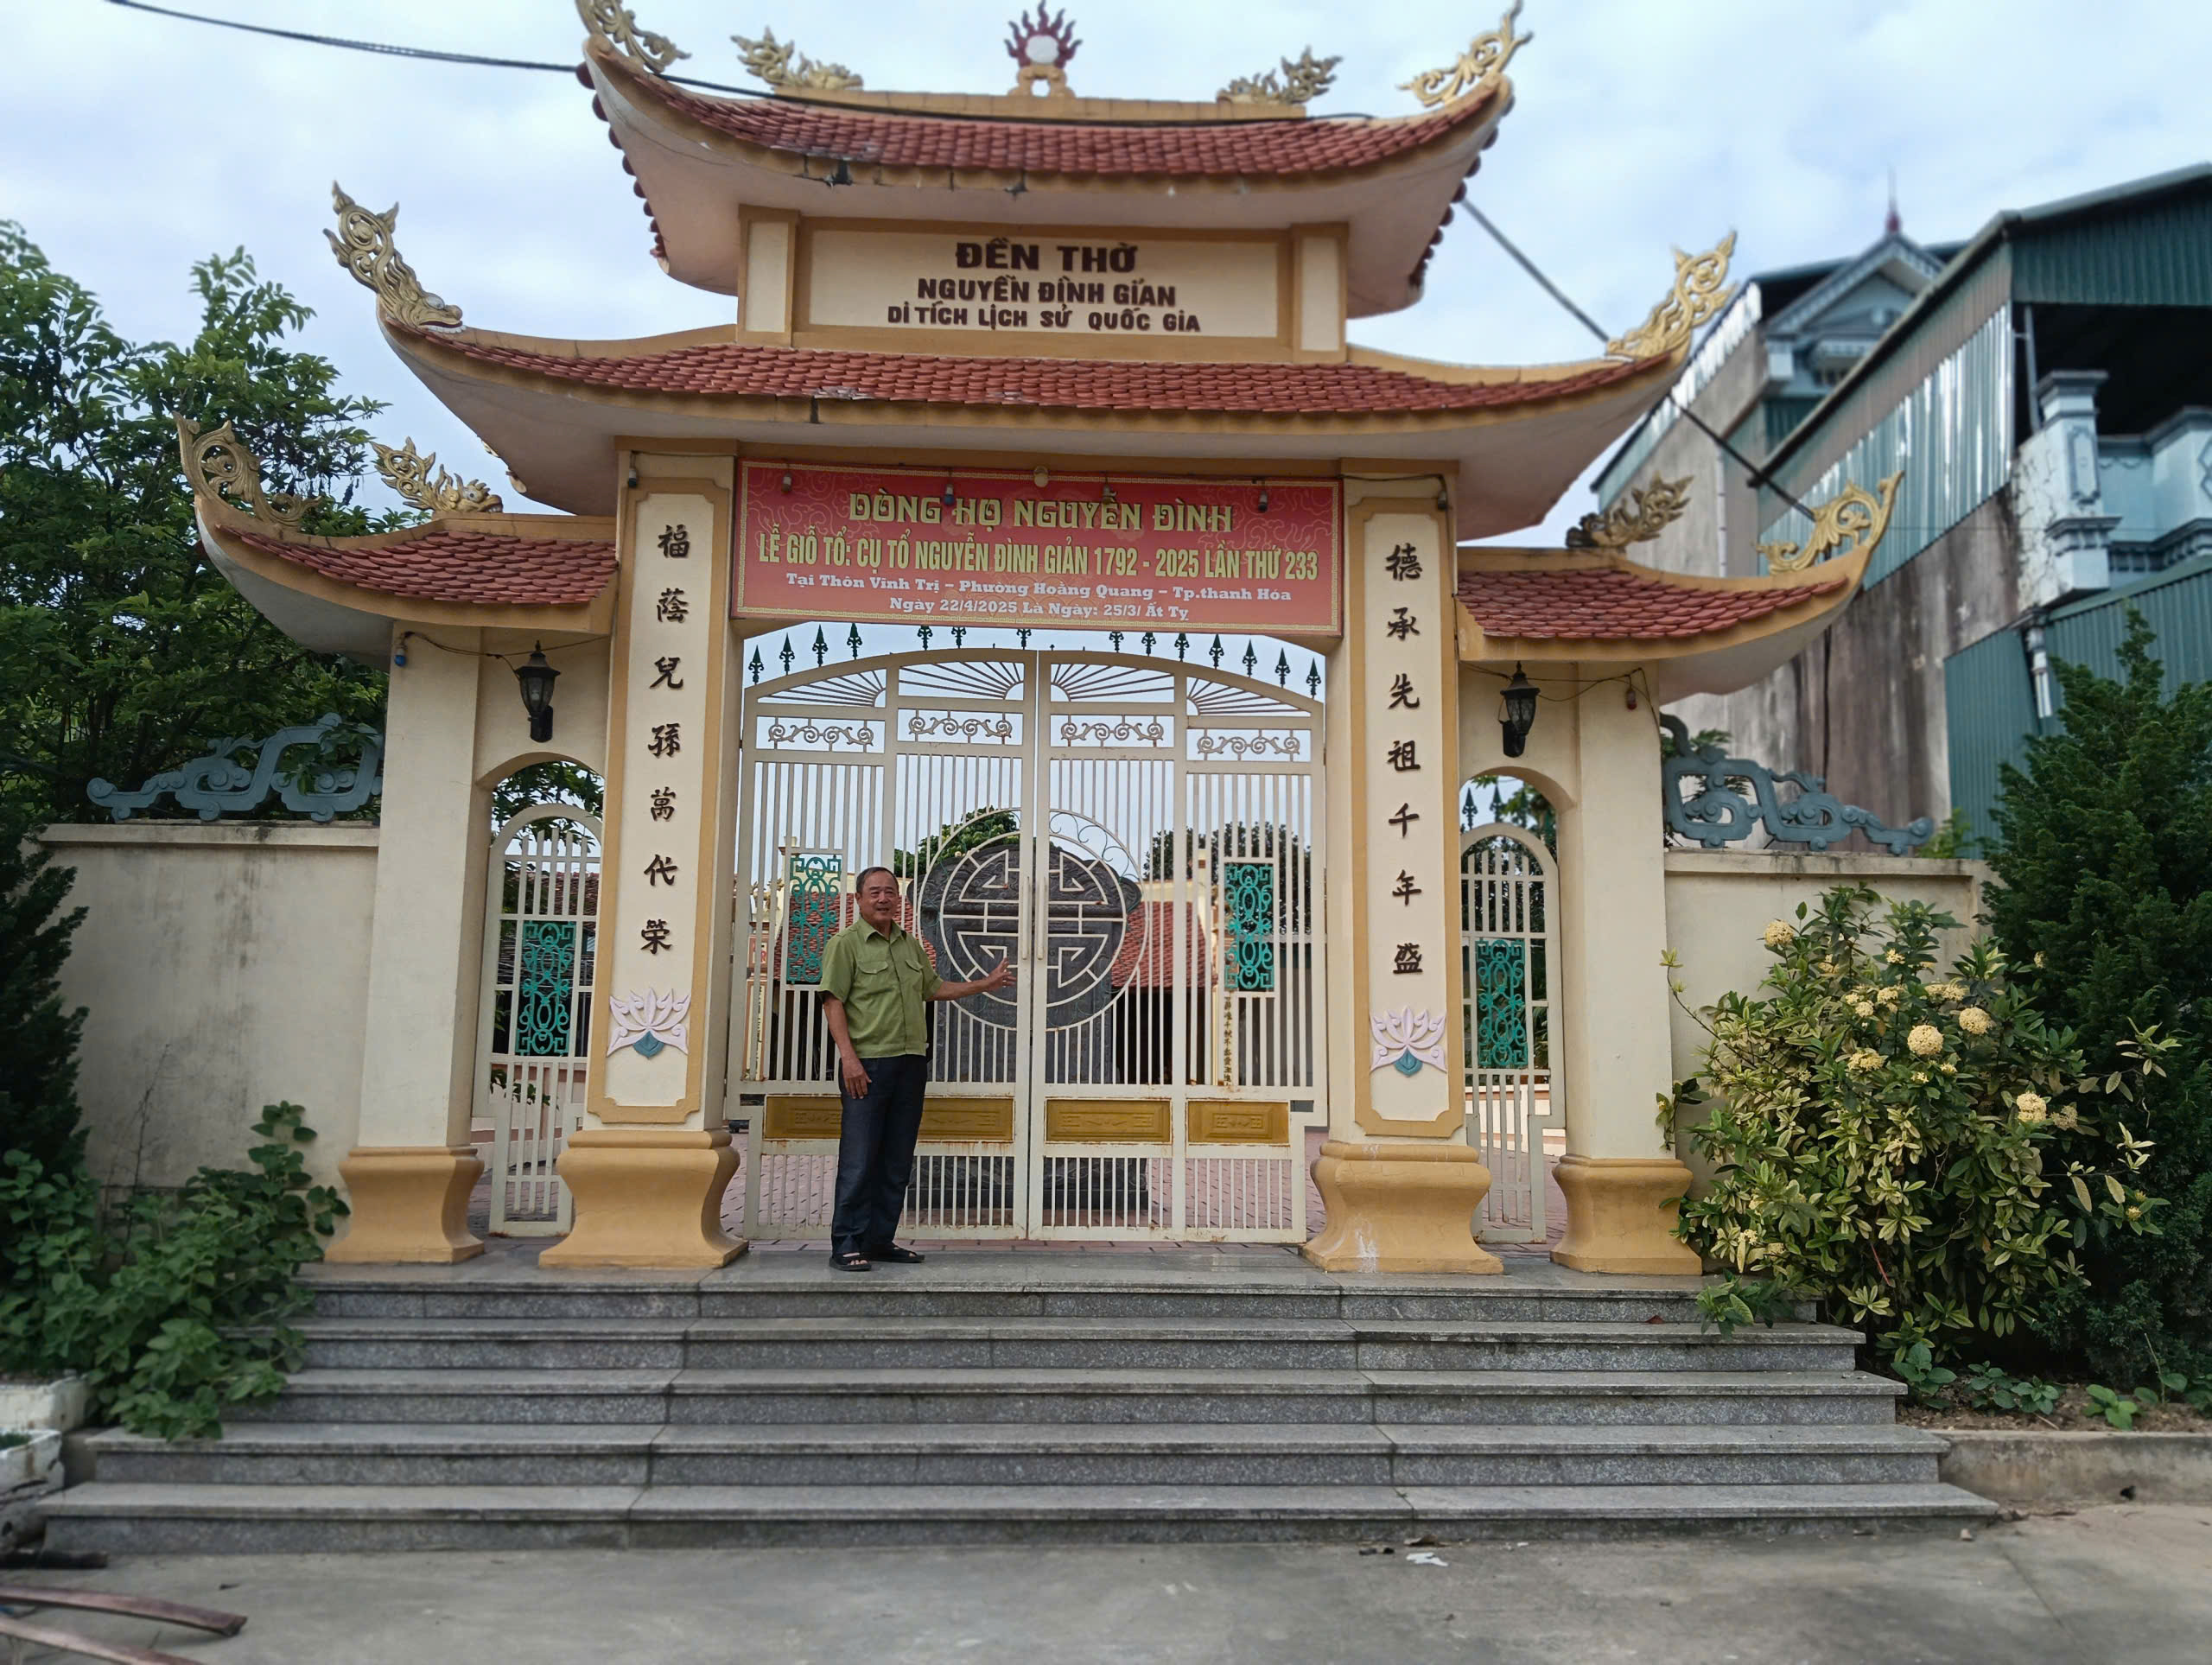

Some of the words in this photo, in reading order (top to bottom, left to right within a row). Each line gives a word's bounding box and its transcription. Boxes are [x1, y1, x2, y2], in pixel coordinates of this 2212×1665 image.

[956, 237, 1039, 270] ĐỀN
[1057, 242, 1138, 273] THỜ
[918, 274, 1030, 302] NGUYỄN
[1038, 275, 1105, 304] ĐÌNH
[914, 300, 968, 326] TÍCH
[978, 303, 1027, 331] LỊCH
[1039, 303, 1073, 328] SỬ
[1088, 308, 1151, 331] QUỐC
[1162, 309, 1201, 333] GIA
[849, 487, 942, 524] DÒNG
[951, 497, 1002, 533] HỌ
[1153, 498, 1233, 533] ĐÌNH
[759, 522, 781, 563] LỄ
[786, 524, 817, 565] GIỖ
[823, 525, 851, 567] TỔ:
[856, 537, 881, 575] CỤ
[887, 528, 911, 569] TỔ
[914, 531, 989, 572] NGUYỄN
[994, 537, 1039, 574] ĐÌNH
[1044, 536, 1089, 575] GIẢN
[1094, 547, 1137, 576] 1792
[1155, 549, 1199, 578] 2025
[1205, 539, 1241, 579] LẦN
[1245, 544, 1283, 580] THỨ
[1285, 551, 1319, 581] 233
[785, 572, 815, 588] Tại
[819, 574, 865, 588] Thôn
[914, 578, 940, 594] Trị
[958, 580, 1030, 598] Phường
[1096, 584, 1154, 601] Quang
[1173, 586, 1253, 601] Tp.thanh
[1256, 587, 1292, 601] Hóa
[889, 596, 936, 614] Ngày
[939, 598, 1018, 614] 22/4/2025
[1022, 601, 1045, 614] Là
[1047, 602, 1099, 618] Ngày:
[1103, 604, 1141, 617] 25/3/
[1145, 601, 1164, 618] Ất
[1384, 542, 1424, 976] 德承先祖千年盛
